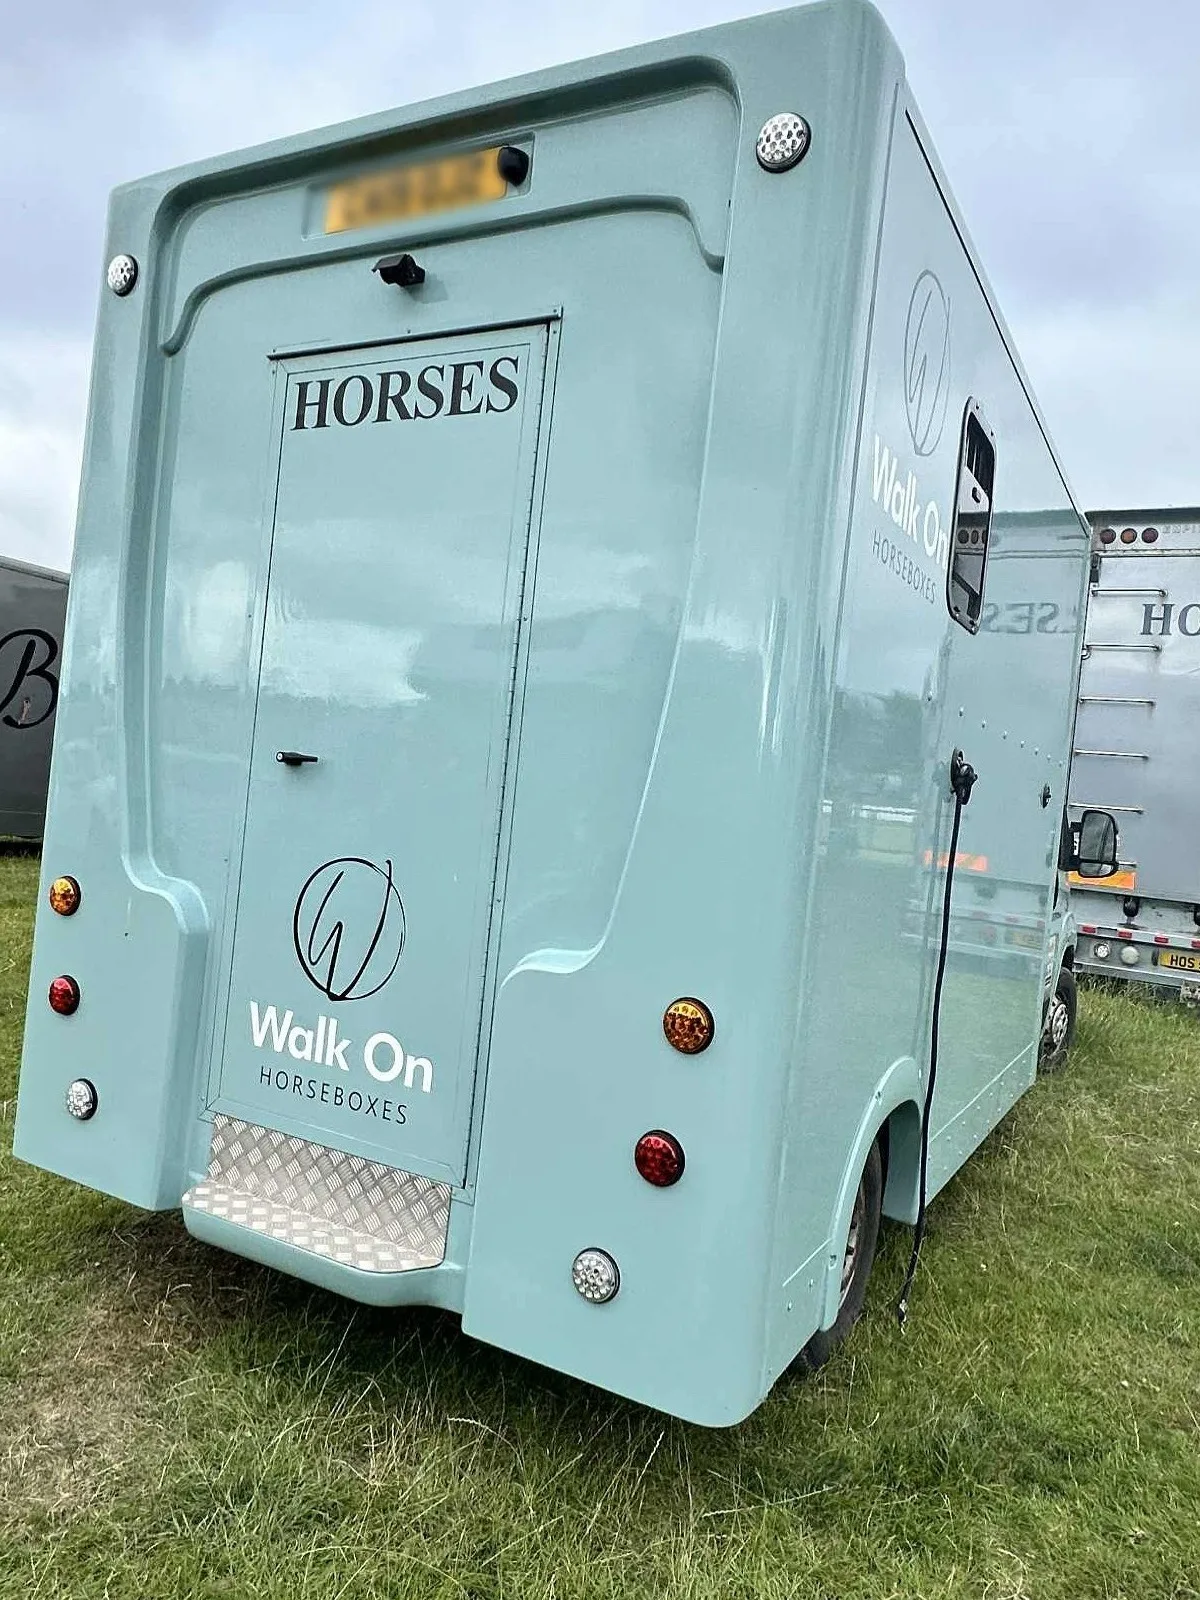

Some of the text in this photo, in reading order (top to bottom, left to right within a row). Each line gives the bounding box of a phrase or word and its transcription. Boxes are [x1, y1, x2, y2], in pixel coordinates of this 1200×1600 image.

[290, 355, 520, 431] HORSES
[872, 434, 948, 571] Walk On
[872, 530, 937, 604] HORSEBOXES
[1140, 603, 1200, 636] HO
[1170, 954, 1196, 969] HOS
[249, 1000, 434, 1094] Walk On
[259, 1065, 408, 1125] HORSEBOXES
